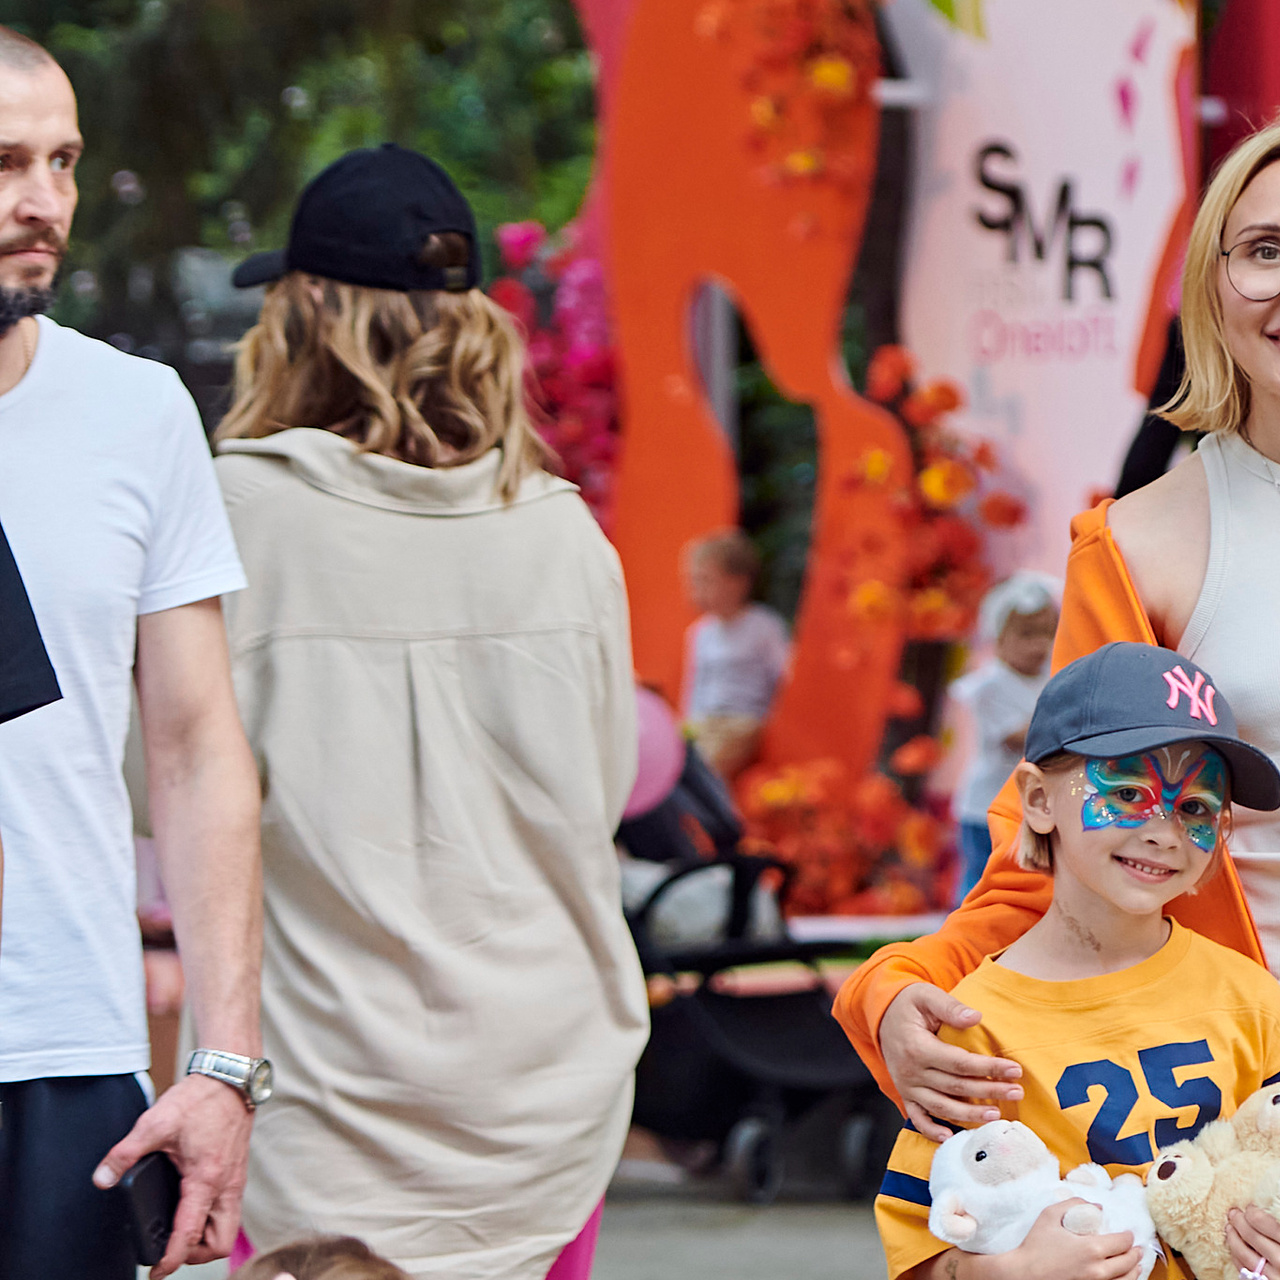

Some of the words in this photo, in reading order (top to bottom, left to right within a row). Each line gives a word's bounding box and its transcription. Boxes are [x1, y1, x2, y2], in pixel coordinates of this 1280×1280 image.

[972, 140, 1114, 302] SMR
[1163, 665, 1218, 726] NY
[1055, 1039, 1222, 1166] 25
